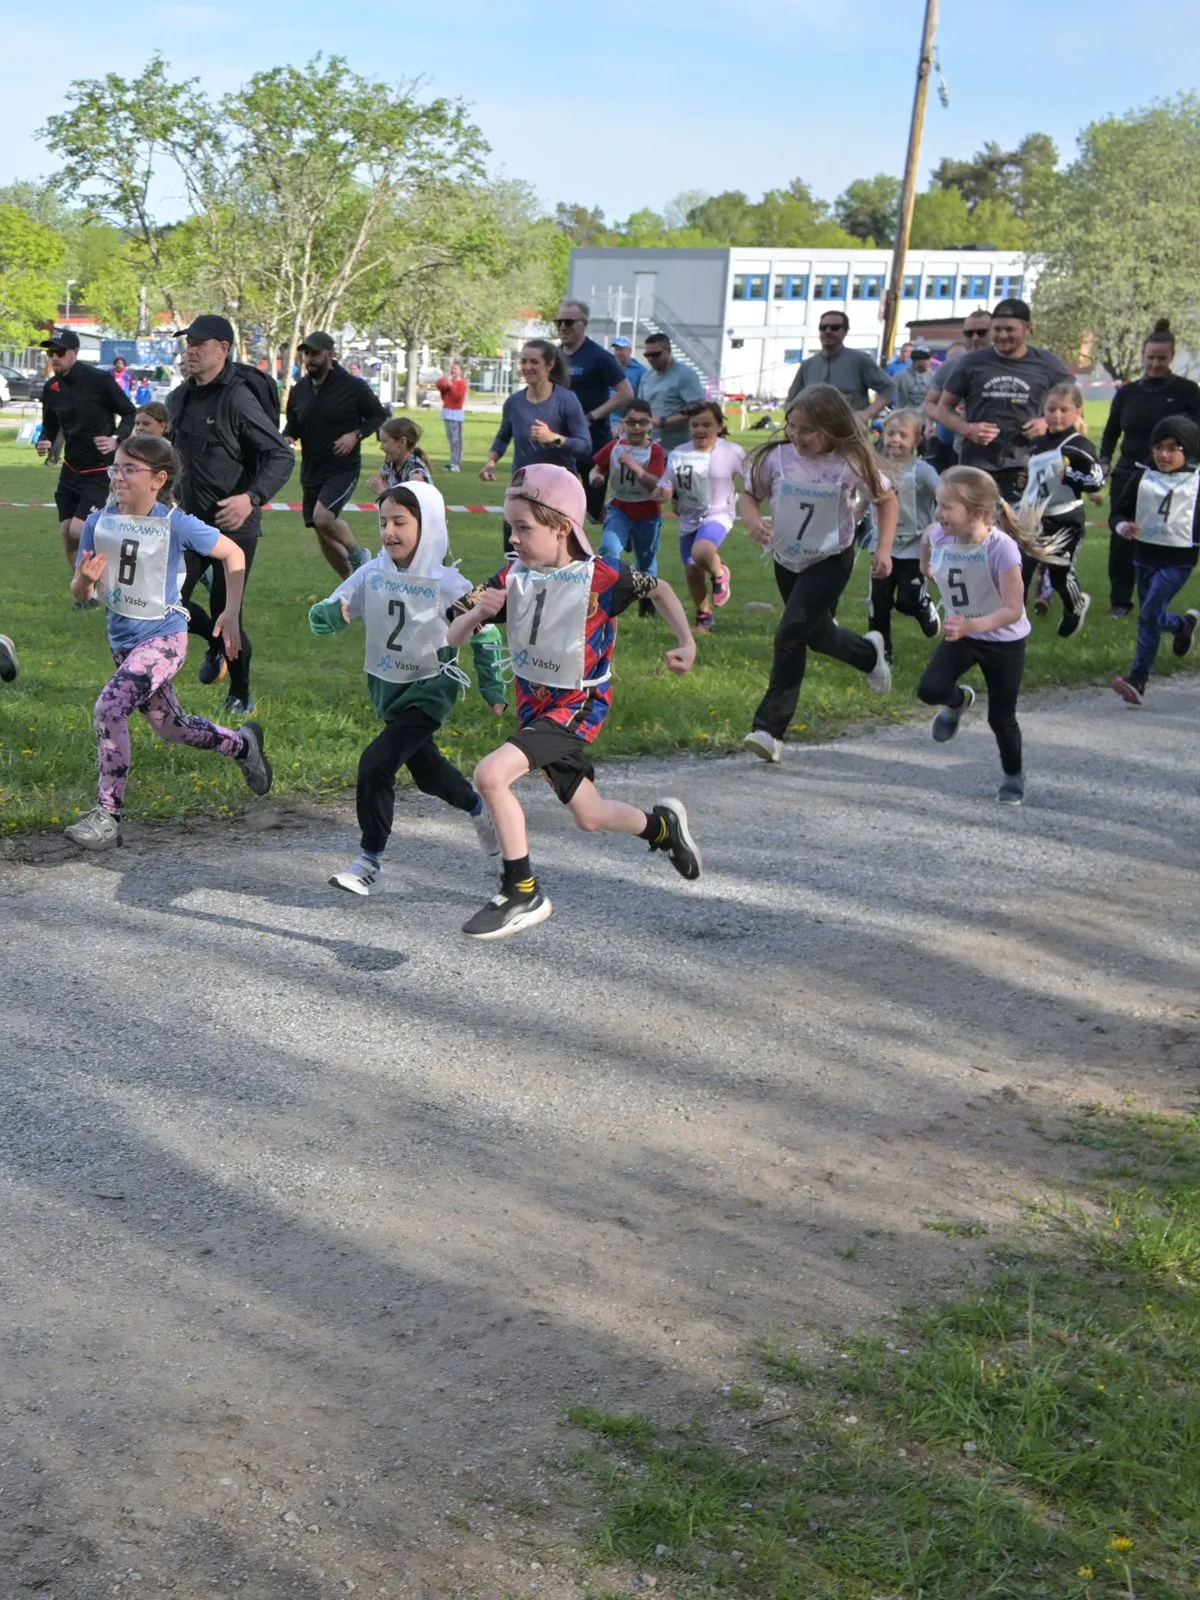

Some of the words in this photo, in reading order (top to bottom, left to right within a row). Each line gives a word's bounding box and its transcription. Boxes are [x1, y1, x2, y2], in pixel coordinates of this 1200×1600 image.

[620, 463, 635, 486] 14
[676, 464, 693, 490] 13
[797, 502, 815, 540] 7
[1157, 489, 1174, 523] 4
[119, 538, 140, 586] 8
[124, 595, 148, 608] Väsby
[948, 568, 969, 607] 5
[386, 599, 405, 652] 2
[529, 589, 547, 645] 1
[394, 660, 420, 671] Väsby
[532, 658, 560, 672] Väsby
